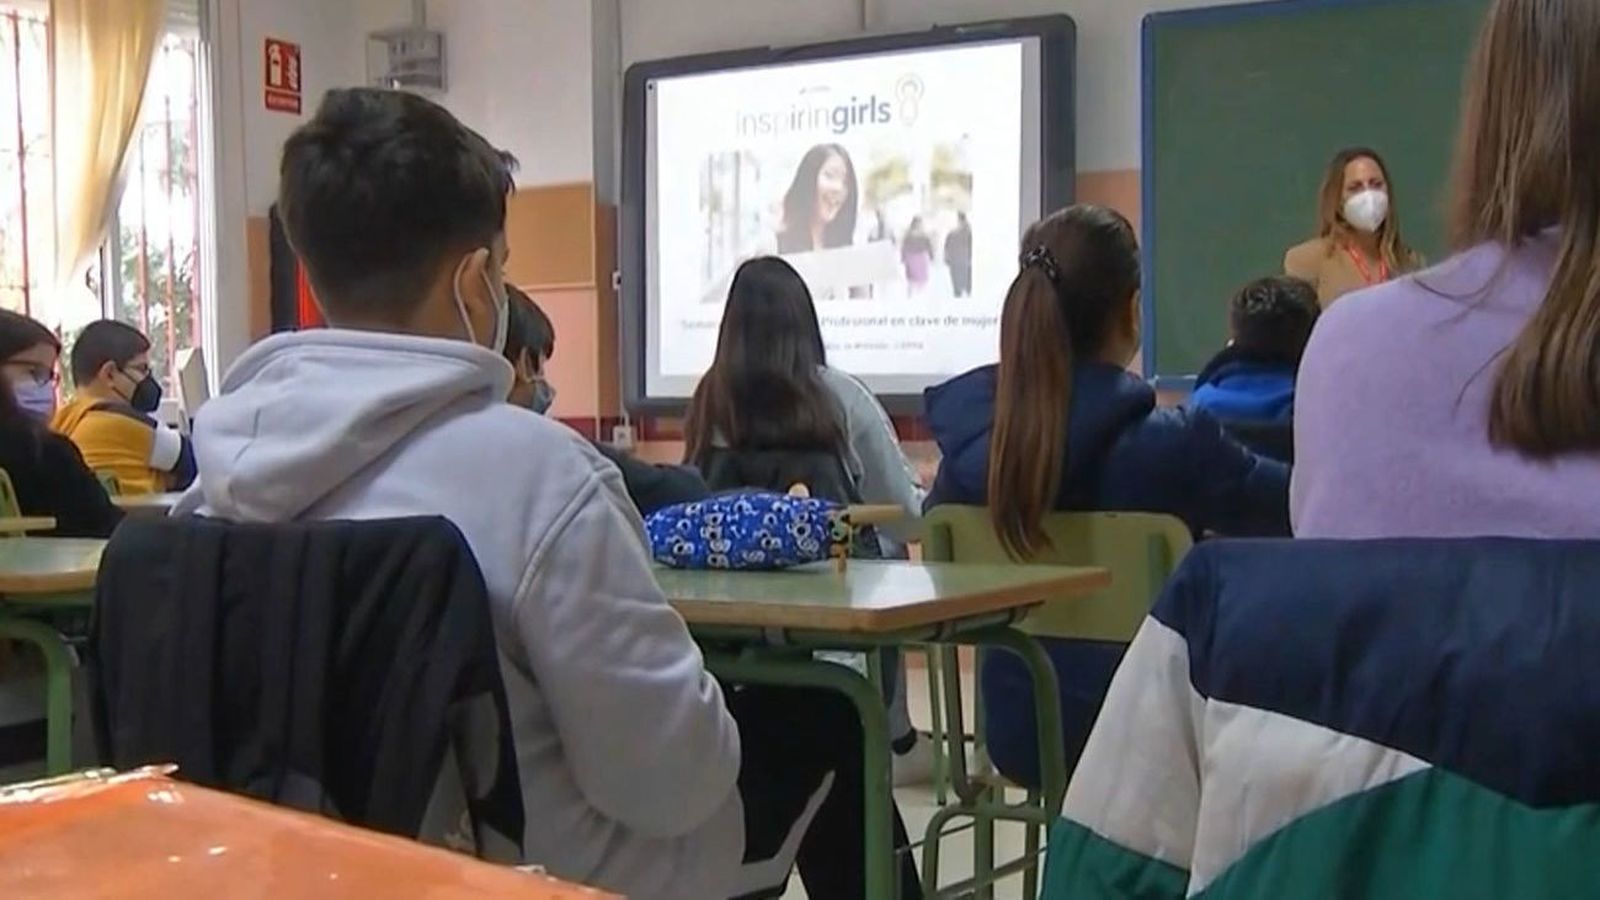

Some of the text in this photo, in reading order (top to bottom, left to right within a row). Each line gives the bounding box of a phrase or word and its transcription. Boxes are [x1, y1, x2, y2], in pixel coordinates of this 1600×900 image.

[890, 317, 906, 327] en
[908, 314, 940, 327] clave
[943, 314, 960, 327] de
[962, 315, 998, 330] mujer
